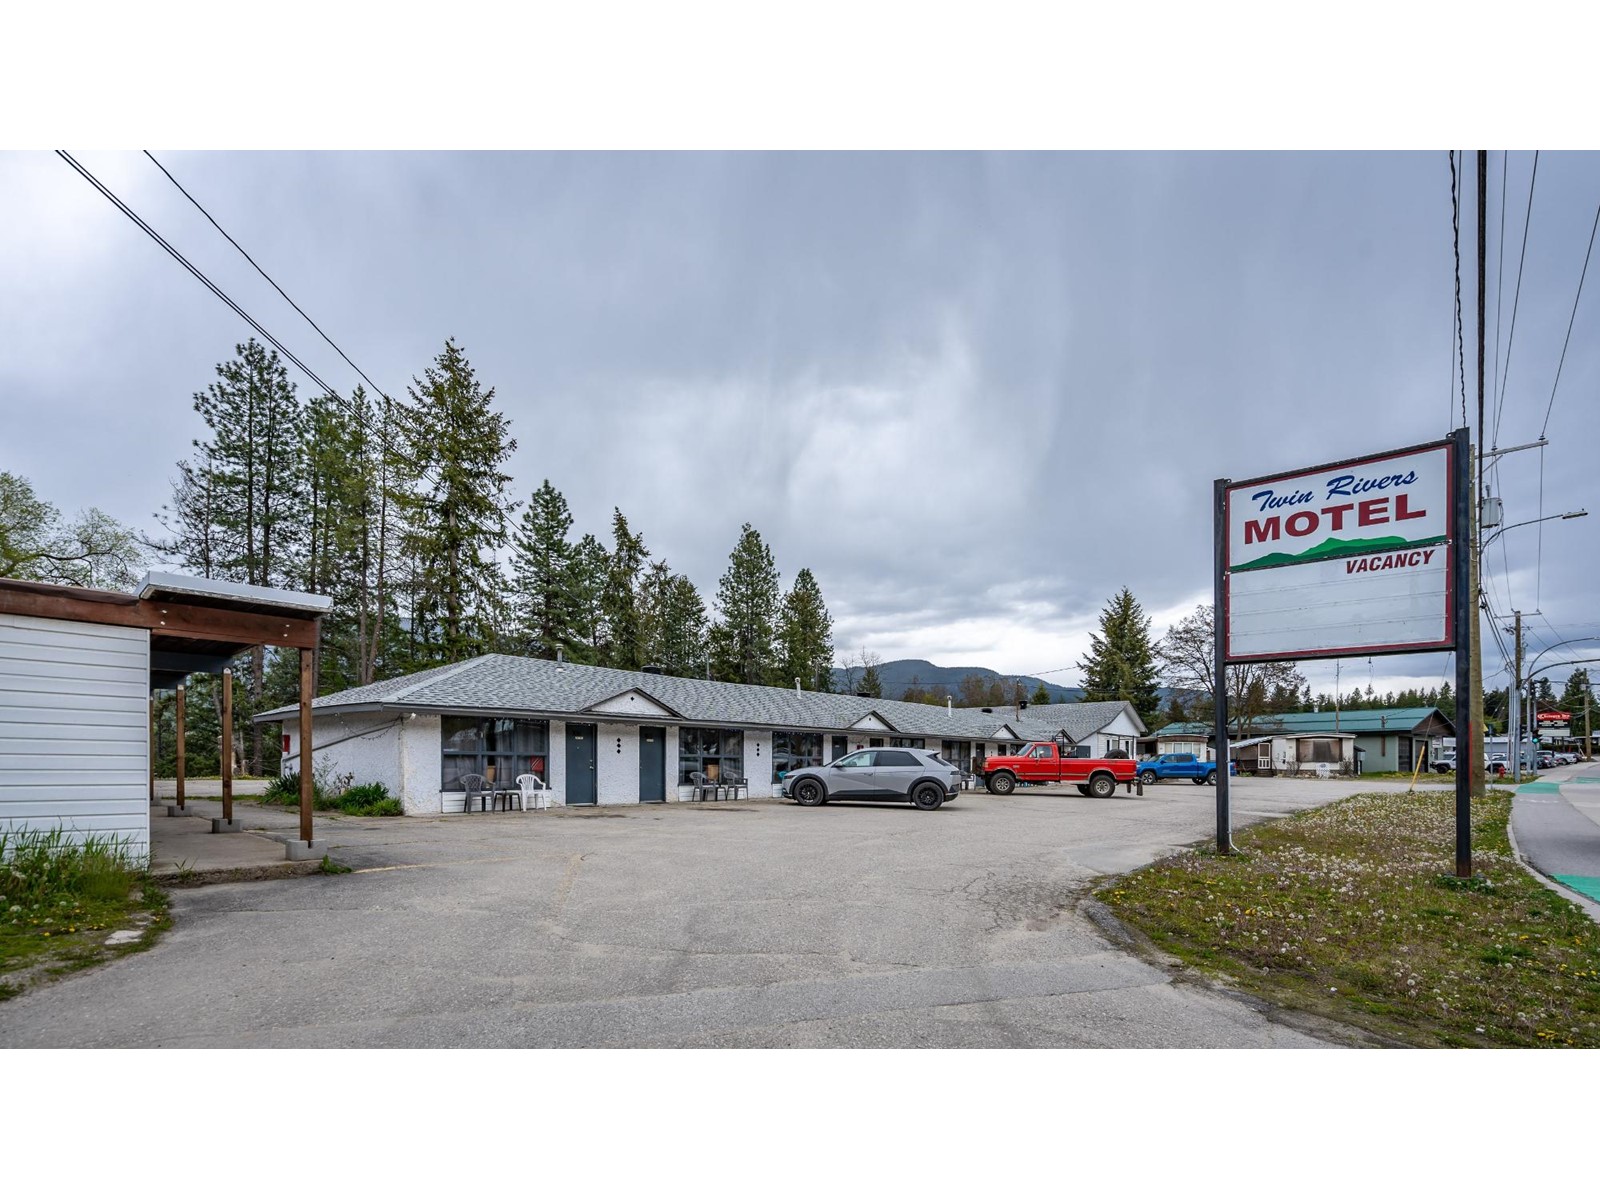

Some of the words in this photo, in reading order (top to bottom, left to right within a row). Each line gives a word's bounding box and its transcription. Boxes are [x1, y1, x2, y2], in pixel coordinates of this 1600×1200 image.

[1251, 490, 1315, 512] Twin
[1326, 470, 1419, 500] Rivers
[1244, 493, 1427, 544] MOTEL
[1345, 549, 1436, 574] VACANCY
